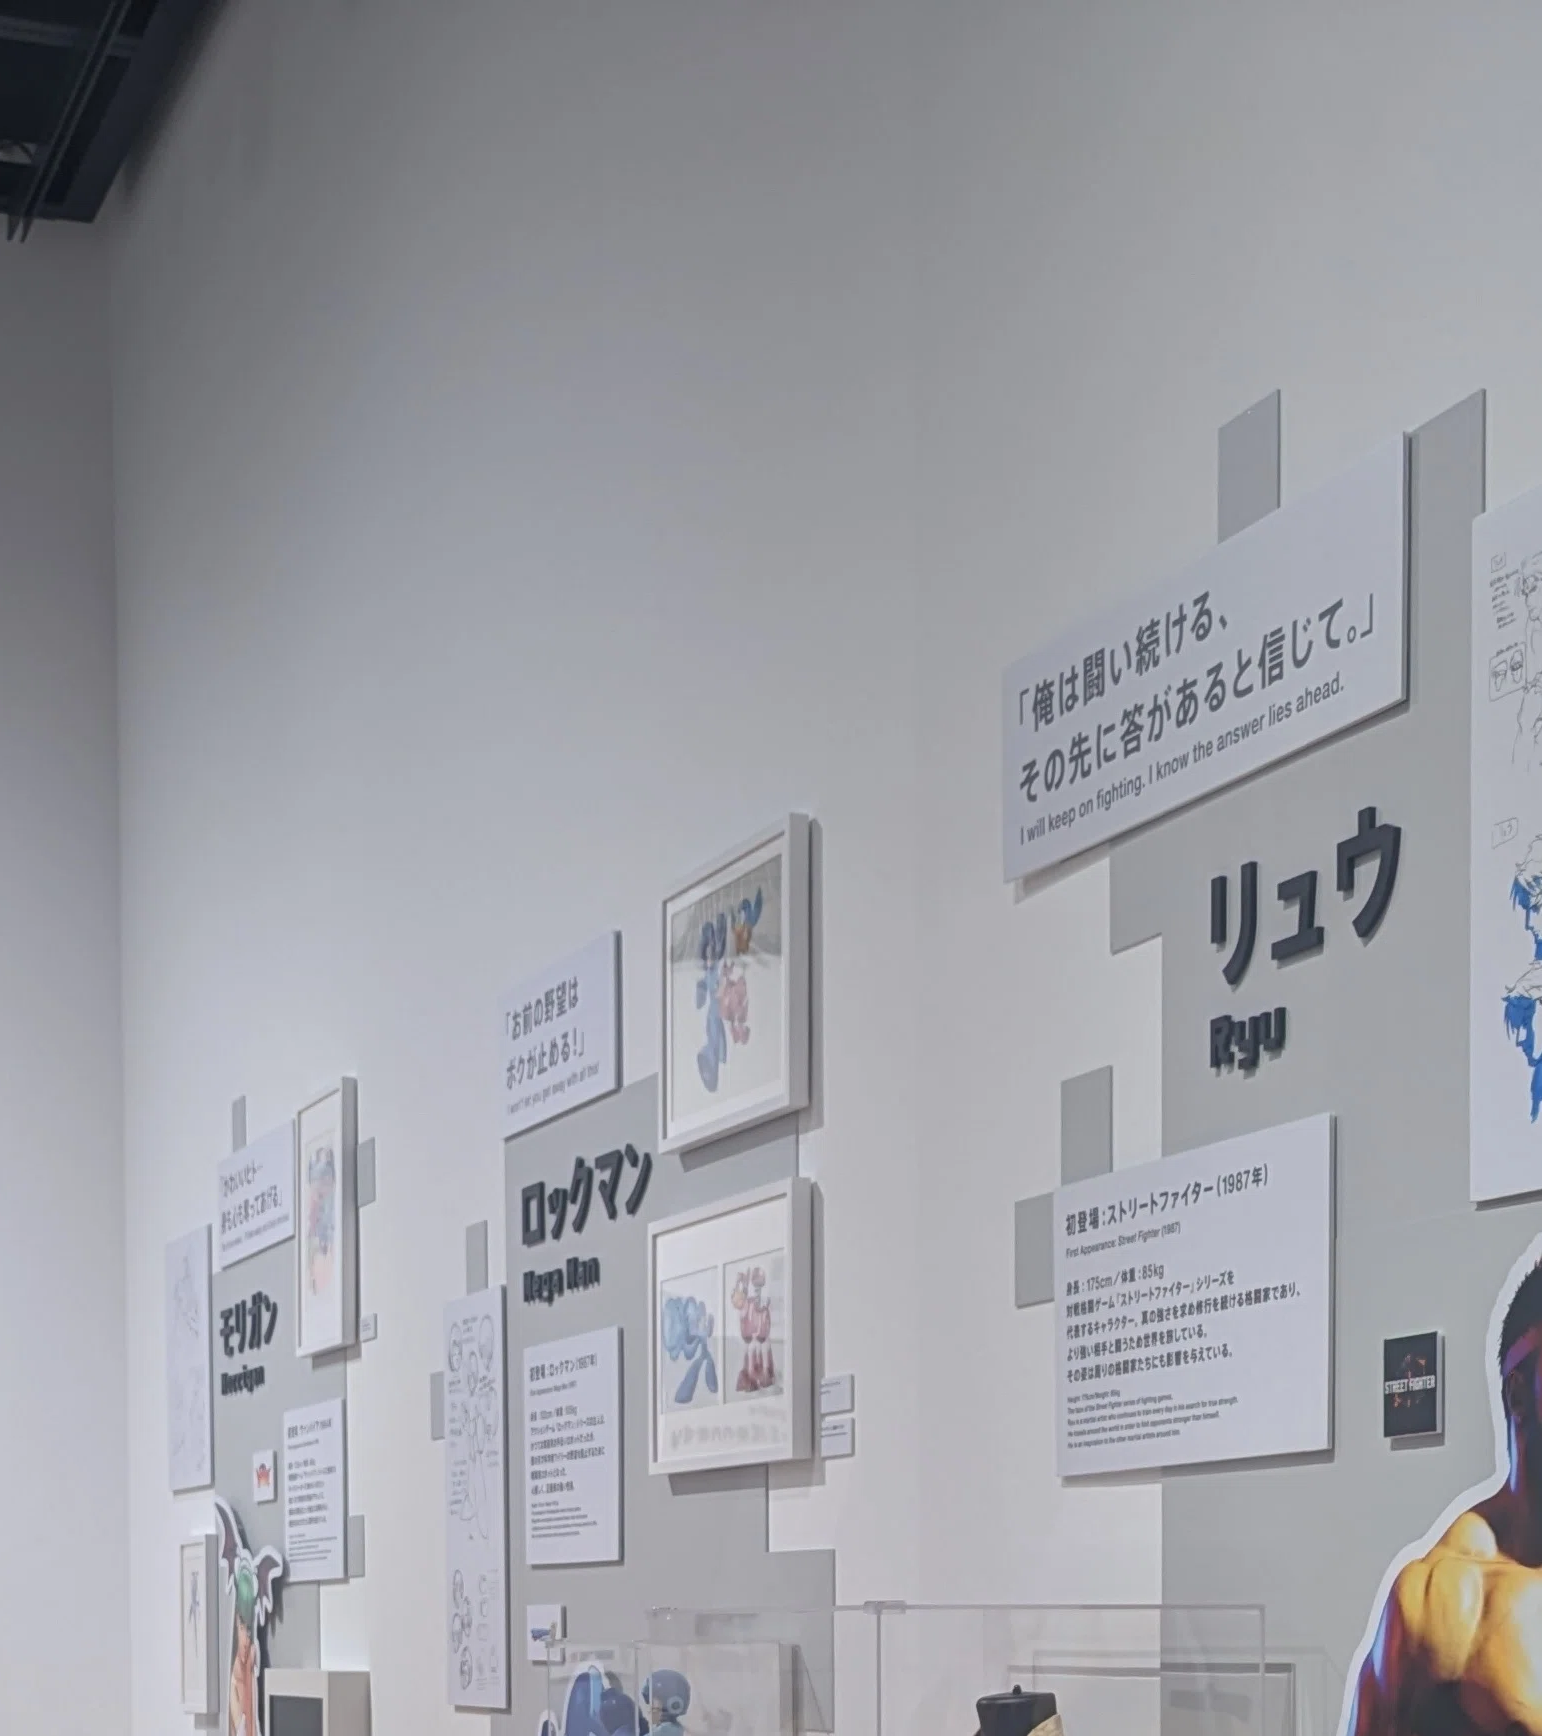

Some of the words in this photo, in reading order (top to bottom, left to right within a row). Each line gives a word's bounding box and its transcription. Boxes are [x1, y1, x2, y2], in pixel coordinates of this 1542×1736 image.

[1019, 590, 1227, 732] 「俺は闘い続ける、
[1019, 593, 1373, 802] その先に答があると信じて。」
[1020, 827, 1024, 845] I
[1027, 817, 1045, 842] will
[1048, 806, 1076, 833] keep
[1079, 798, 1094, 819] on
[1096, 775, 1146, 812] fighting.
[1156, 751, 1189, 781] know
[1192, 738, 1213, 764] the
[1216, 714, 1265, 753] answer
[1268, 700, 1292, 728] lies
[1295, 672, 1344, 715] ahead.
[1211, 807, 1402, 986] リュウ
[1210, 1007, 1287, 1070] Ryu
[522, 1143, 653, 1247] ロックマン
